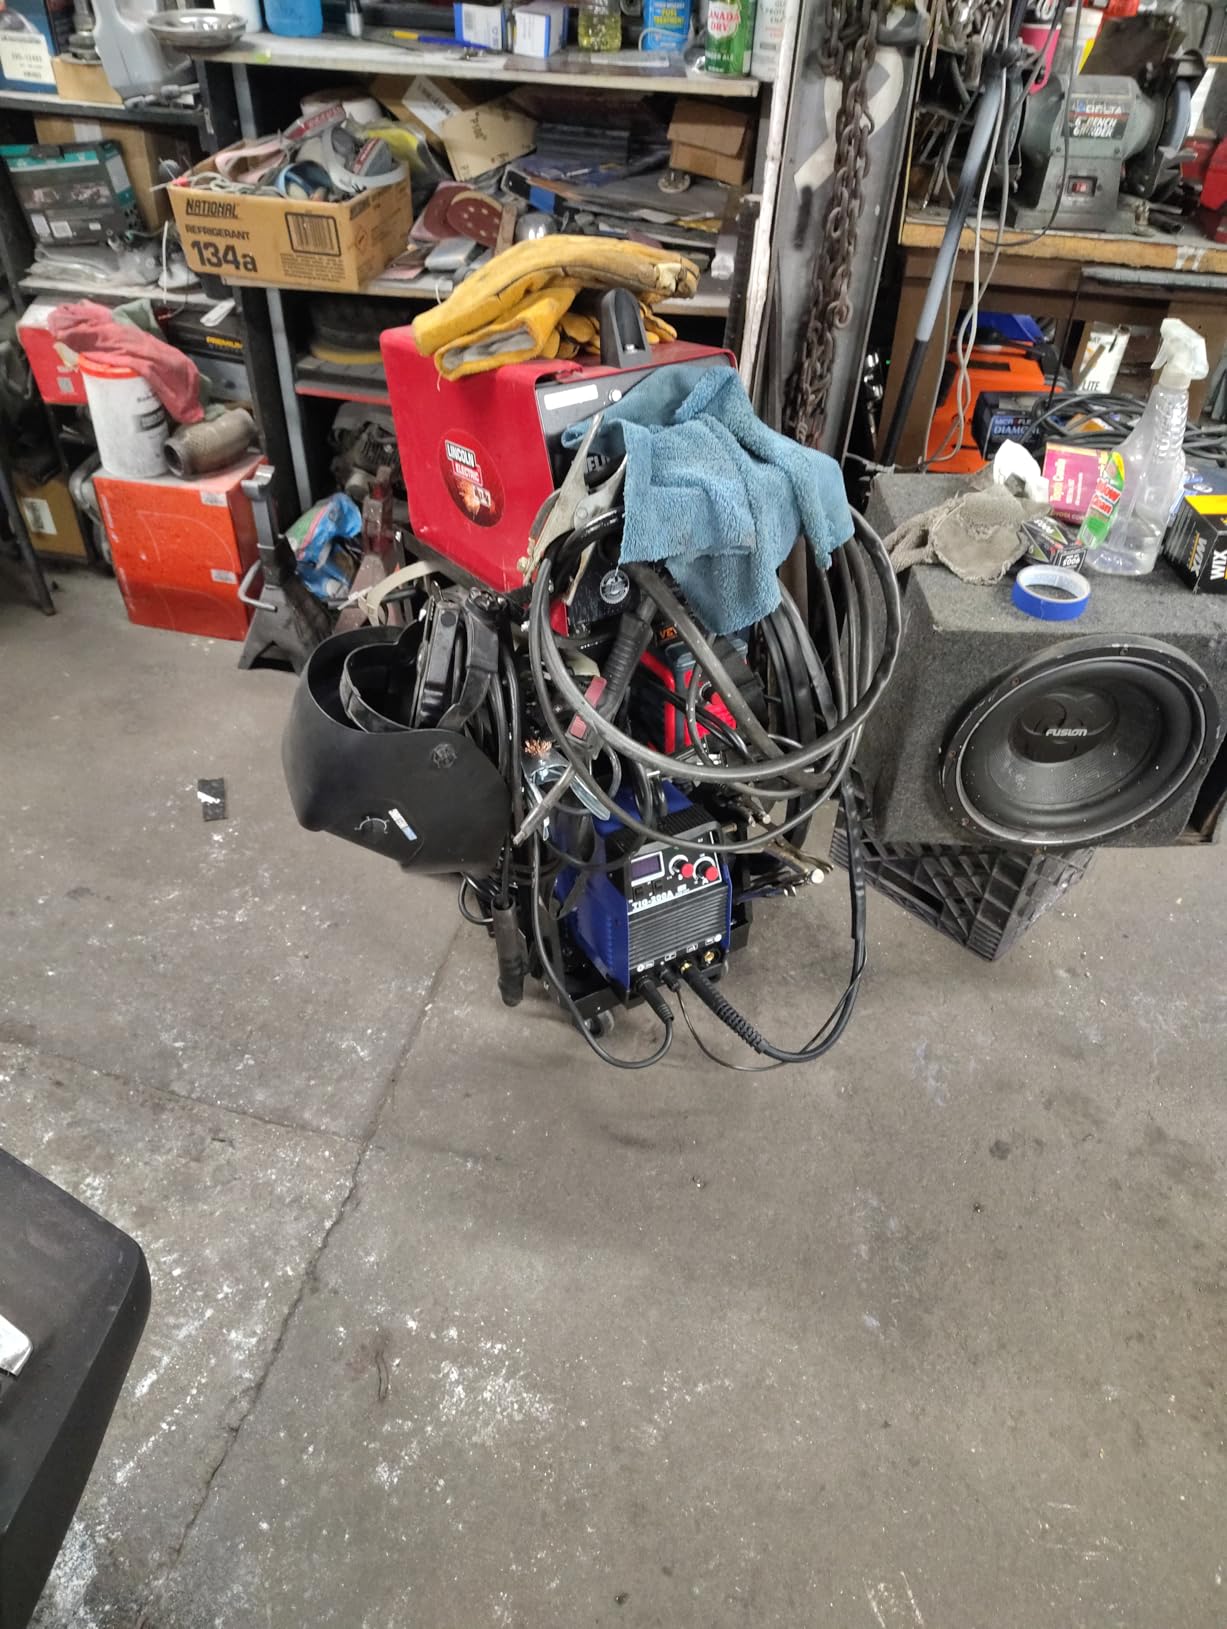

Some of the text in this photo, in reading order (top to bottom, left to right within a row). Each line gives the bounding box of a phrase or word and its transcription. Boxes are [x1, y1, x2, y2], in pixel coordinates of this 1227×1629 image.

[708, 11, 740, 20] ANADA
[711, 23, 730, 32] DRY
[1085, 104, 1122, 115] DELTA
[185, 199, 239, 218] NATIONAL
[185, 224, 250, 240] REFRIGERANT
[191, 240, 258, 272] 134a
[1081, 380, 1100, 391] LITE
[446, 443, 476, 468] LINCOLN
[455, 462, 481, 483] ELECTRIC
[1210, 550, 1227, 580] WIX
[1045, 728, 1088, 737] FUSION
